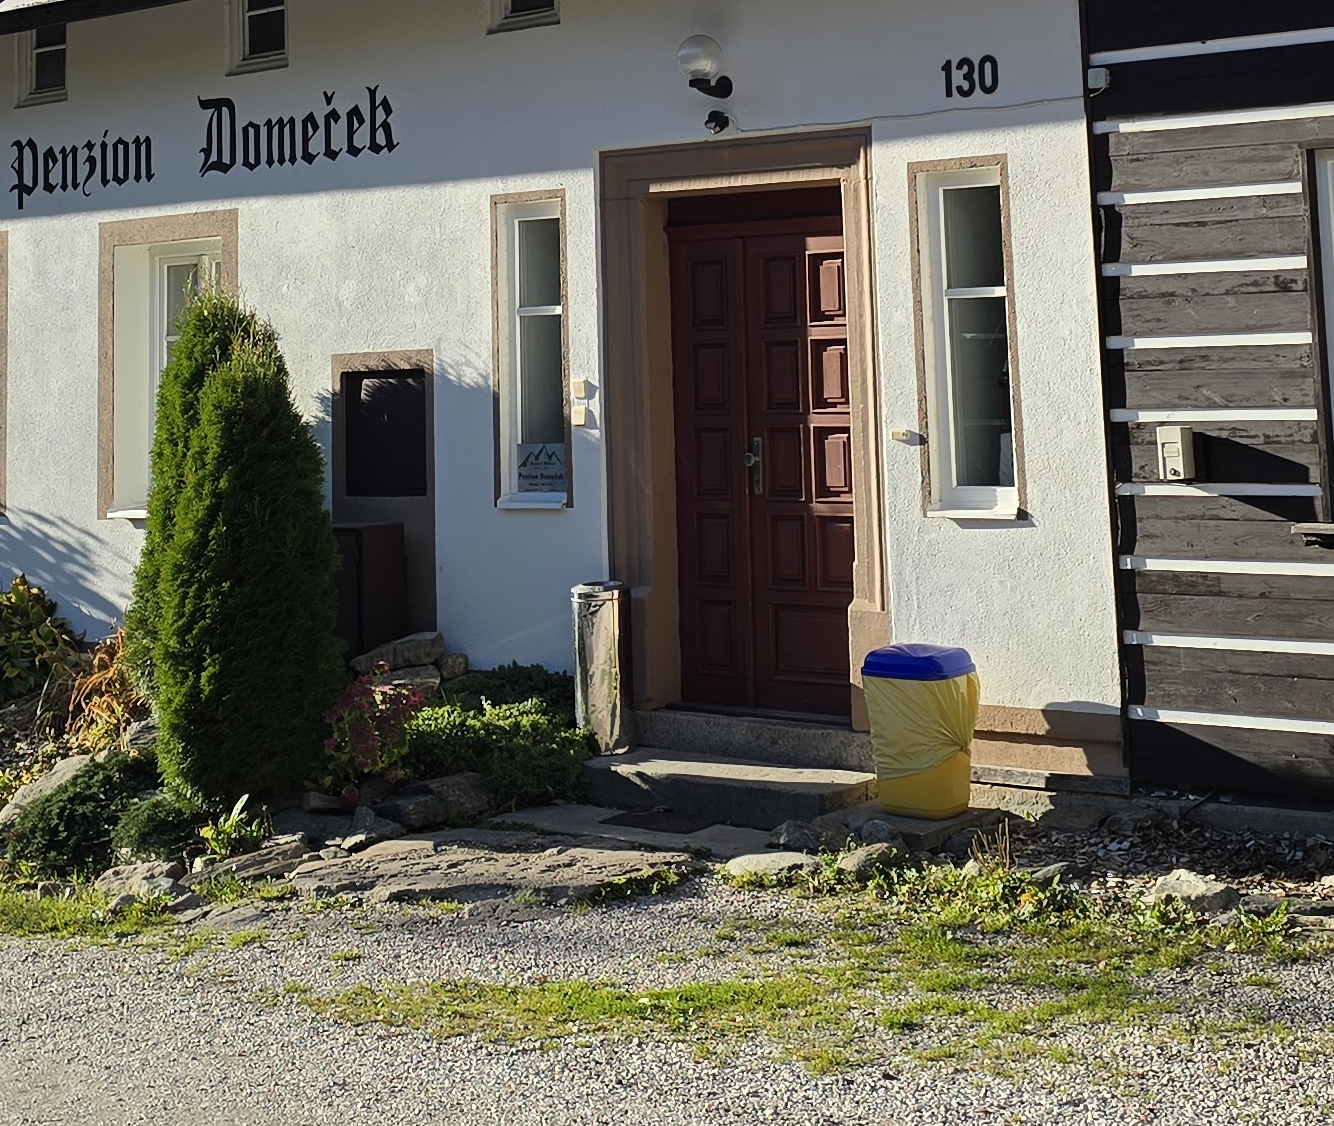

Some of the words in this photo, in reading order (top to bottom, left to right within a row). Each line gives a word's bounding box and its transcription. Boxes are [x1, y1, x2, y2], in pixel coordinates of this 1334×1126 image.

[940, 54, 999, 98] 130
[9, 128, 155, 210] Penzion
[197, 84, 400, 178] Domeček
